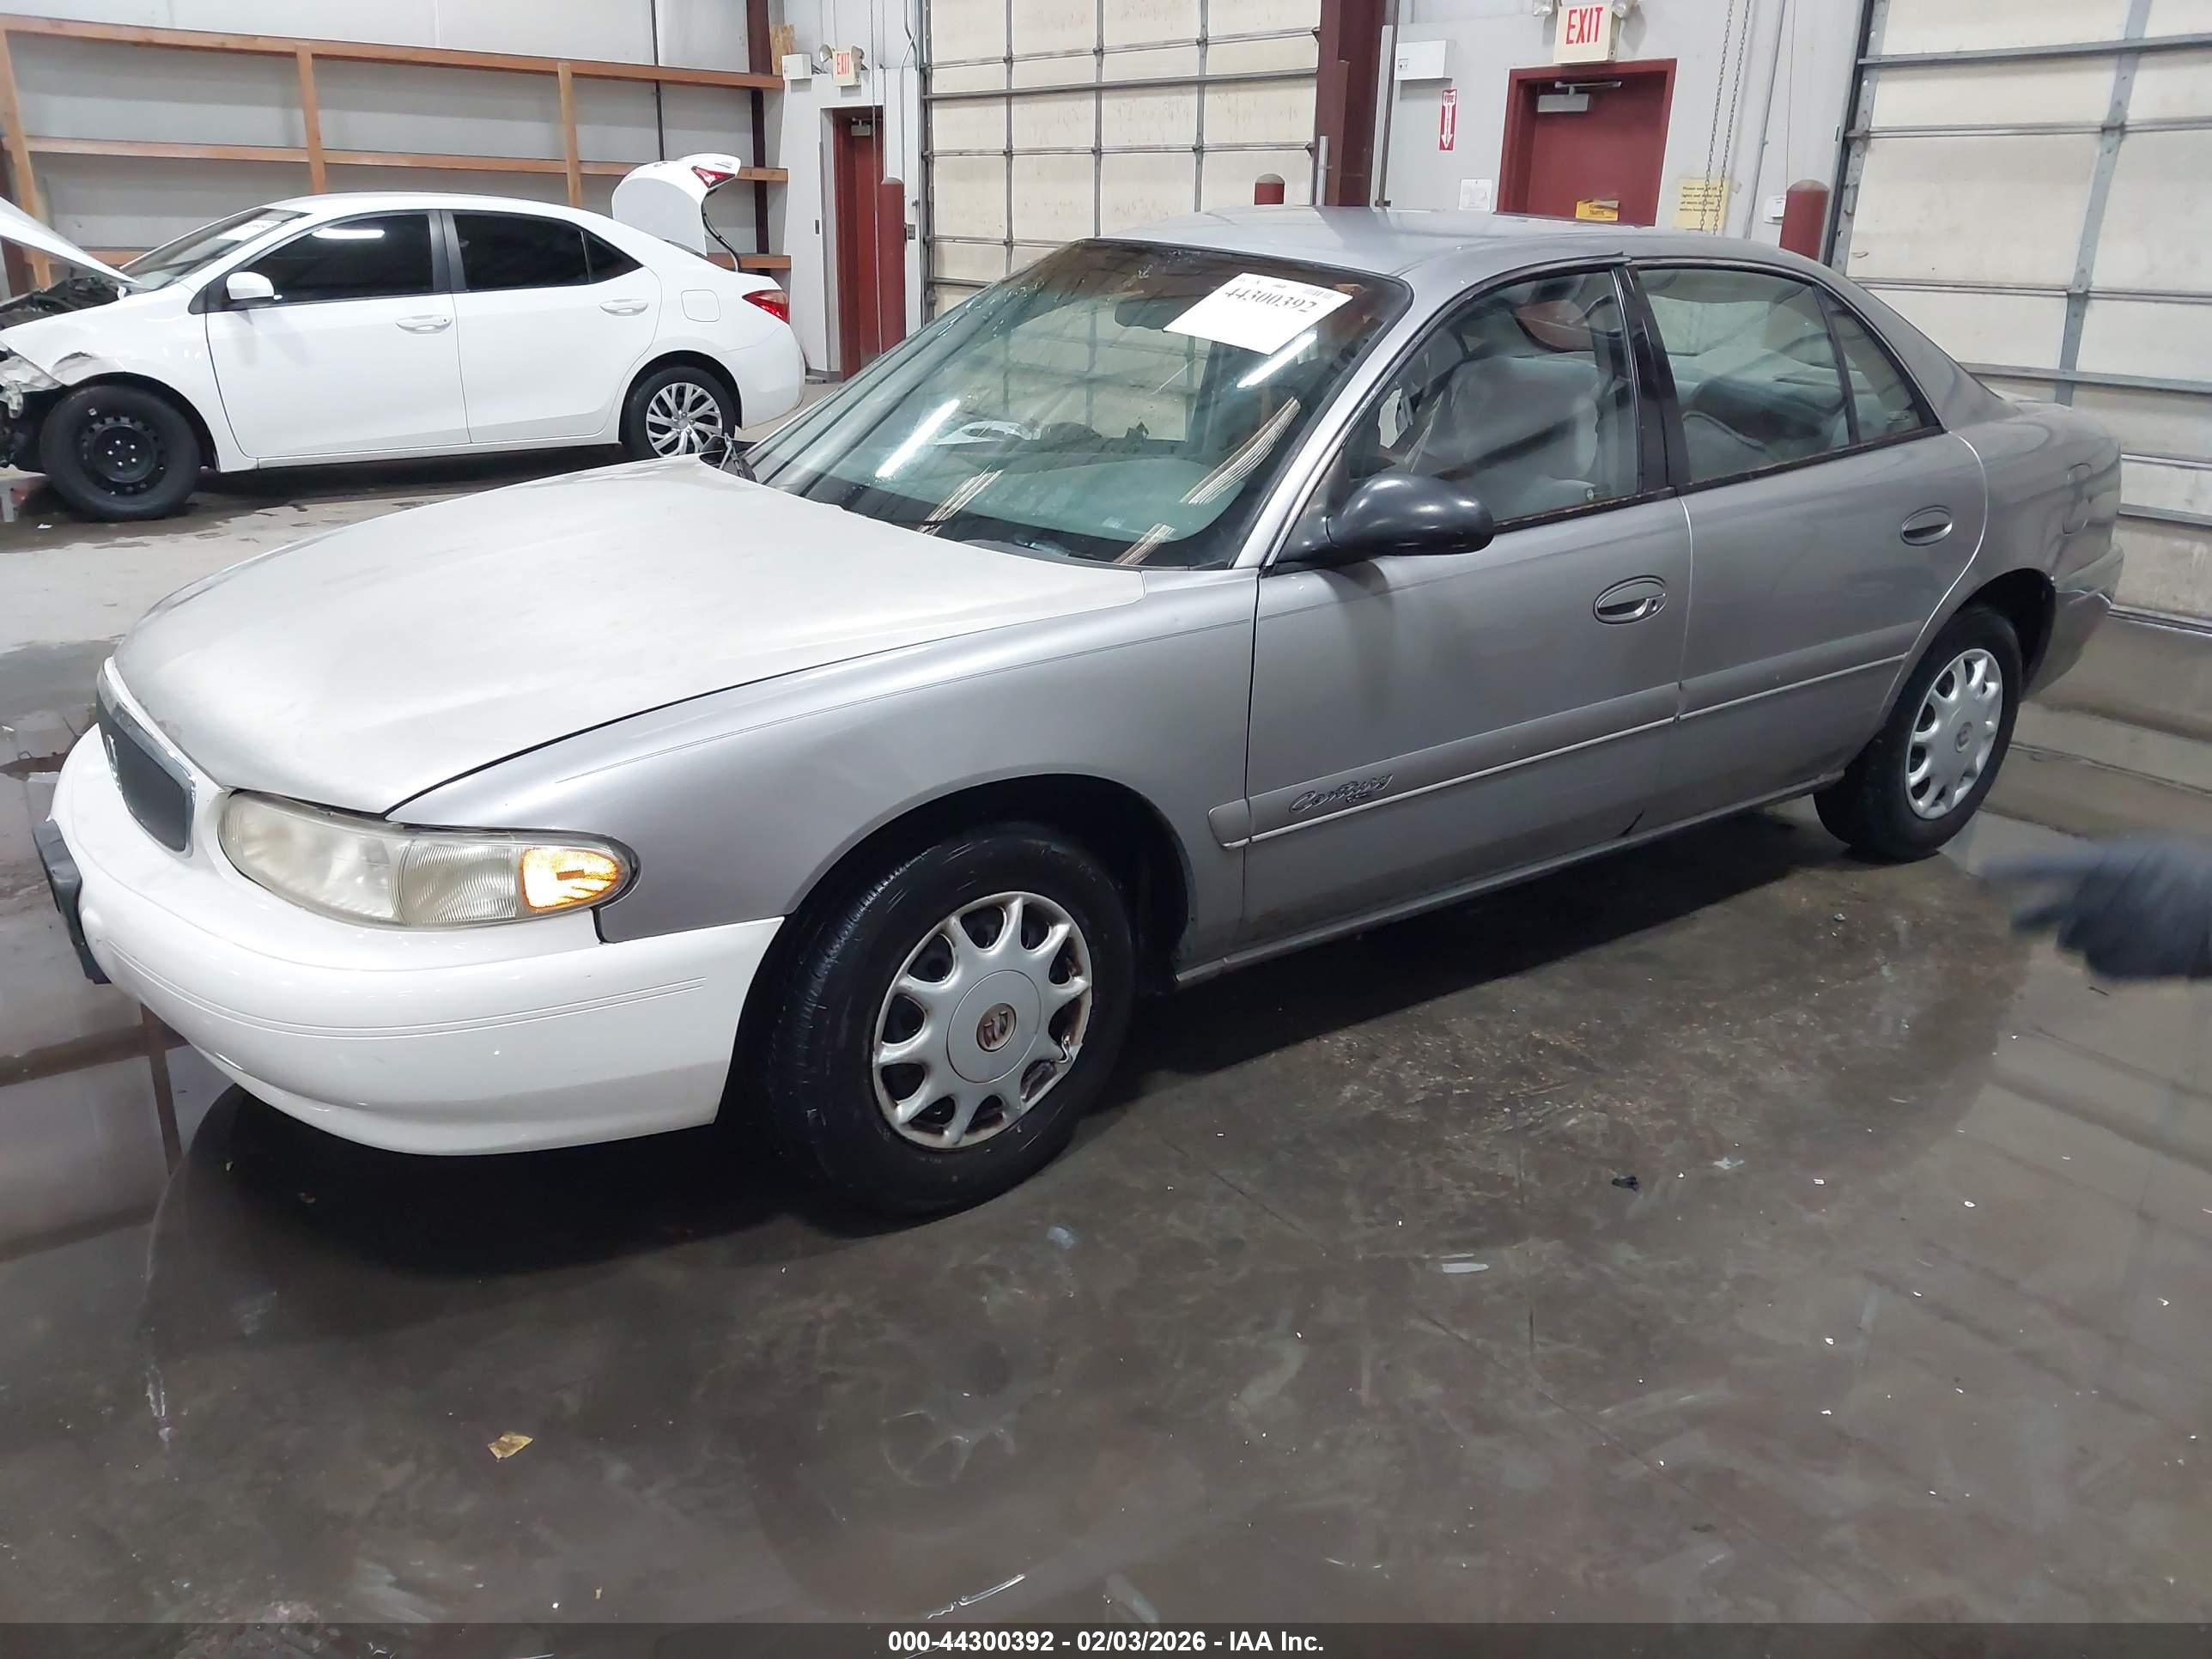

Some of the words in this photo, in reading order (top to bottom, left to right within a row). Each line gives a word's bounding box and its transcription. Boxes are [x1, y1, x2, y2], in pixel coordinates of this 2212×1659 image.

[1566, 7, 1603, 45] EXIT
[836, 52, 850, 75] EXIT
[1225, 288, 1317, 313] 44300392
[1289, 774, 1394, 813] Century
